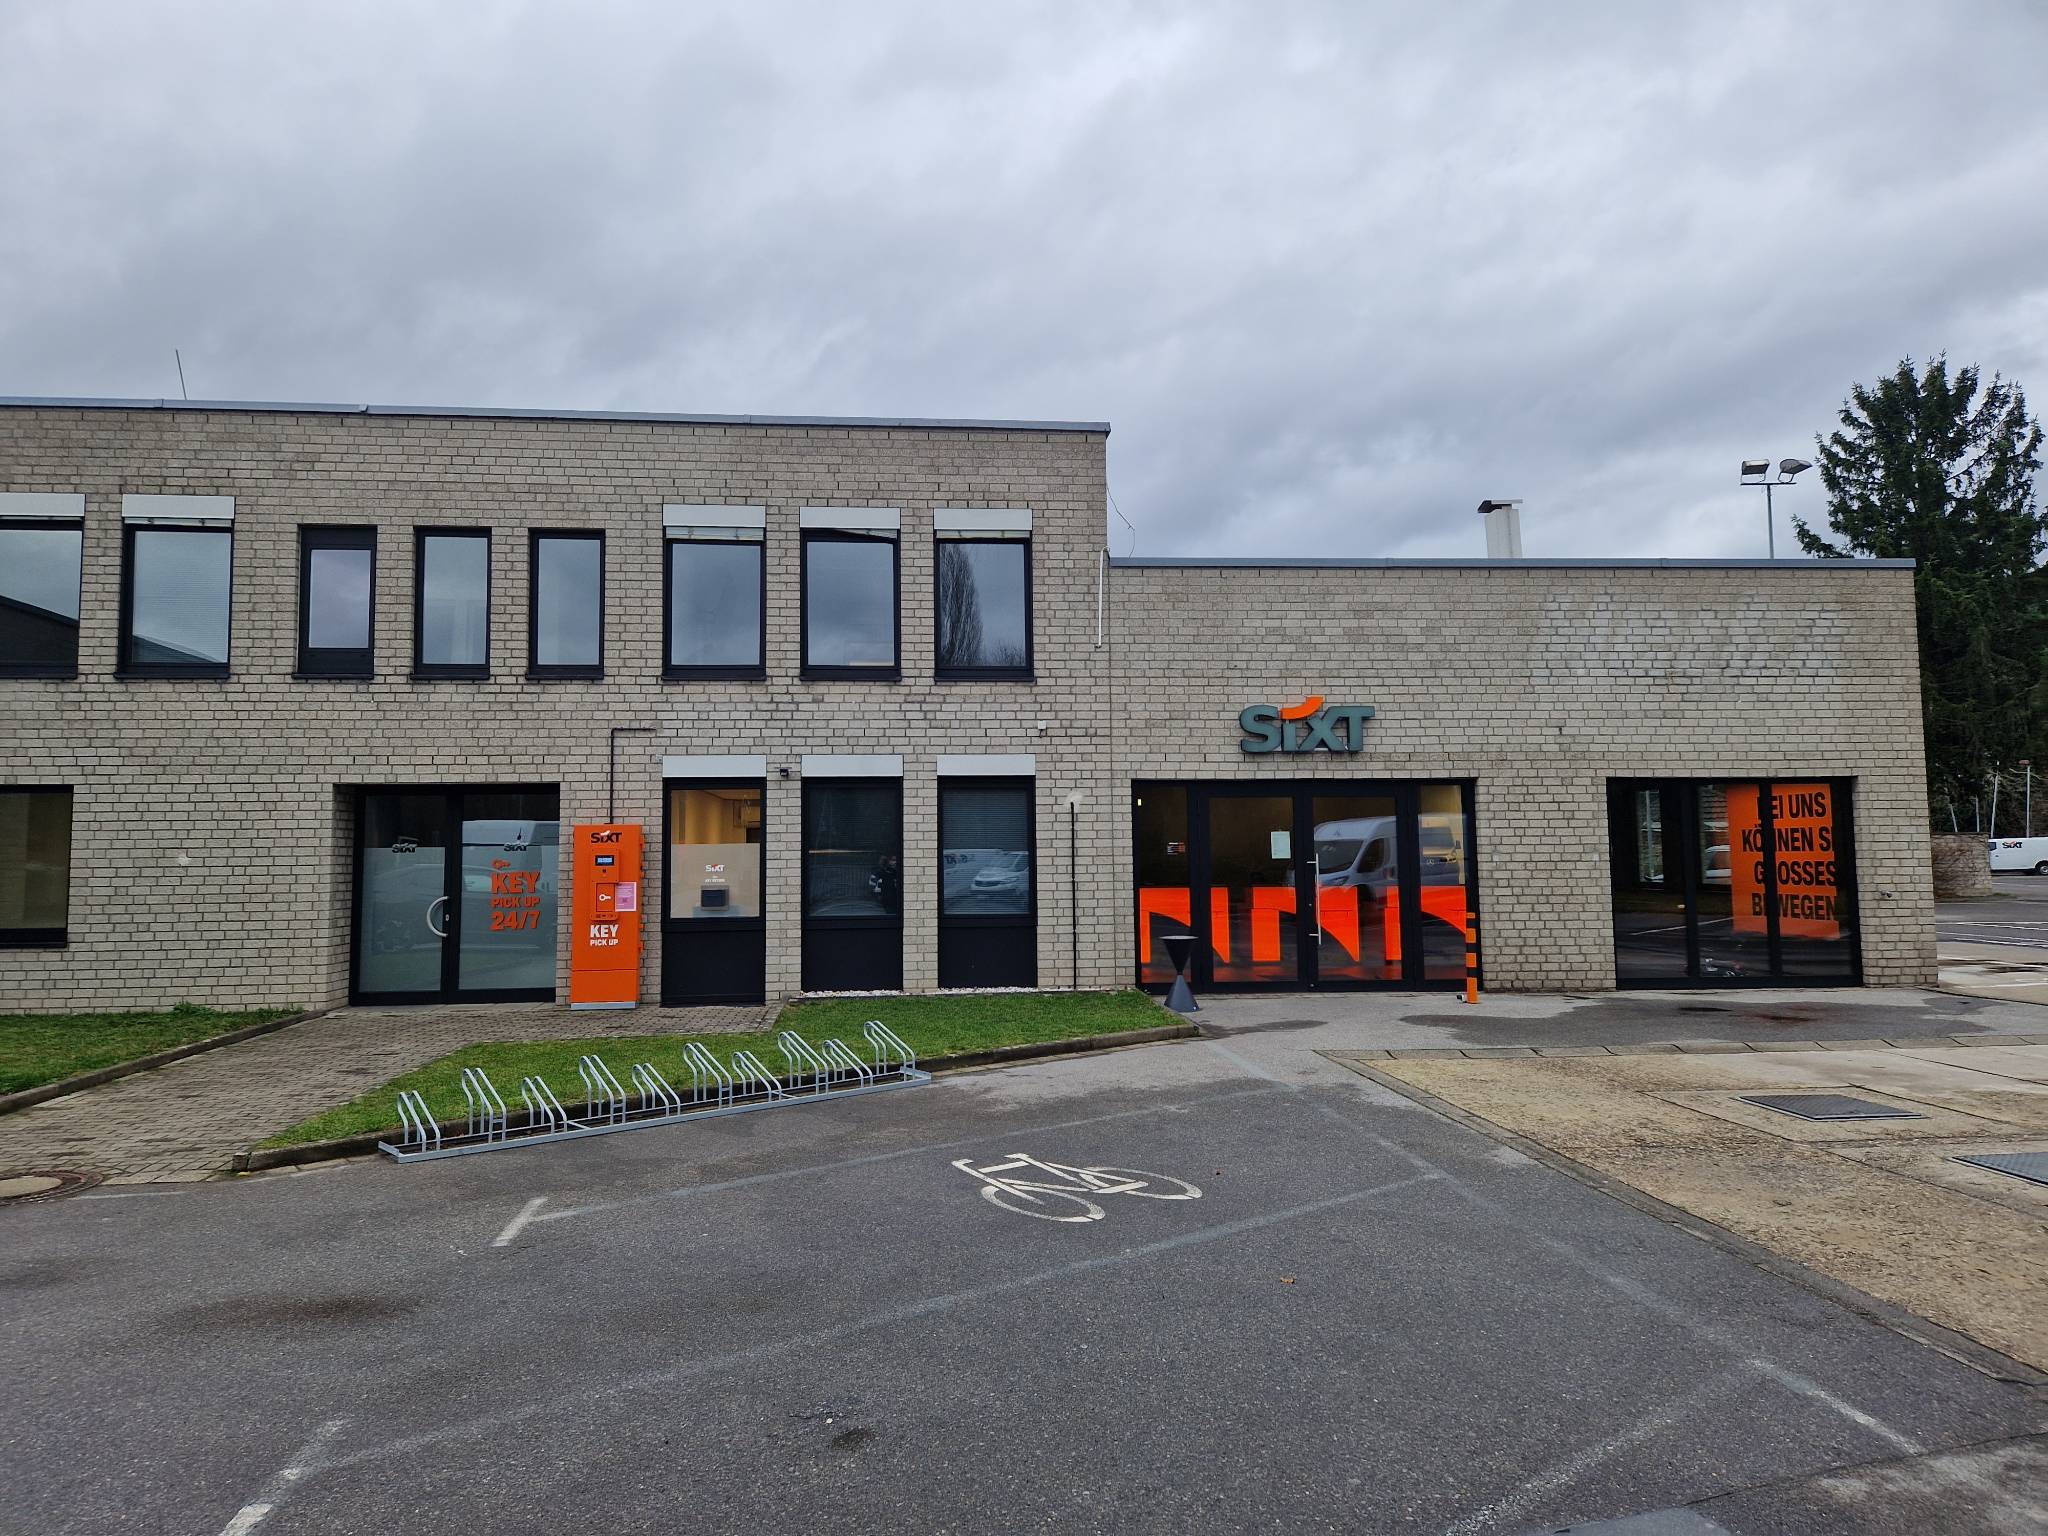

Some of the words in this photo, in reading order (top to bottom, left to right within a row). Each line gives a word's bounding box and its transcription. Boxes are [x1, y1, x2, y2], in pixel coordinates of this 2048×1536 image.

[1788, 792, 1827, 819] UNS
[1741, 823, 1815, 852] KÖNEN
[491, 871, 540, 894] KEY
[1754, 860, 1838, 887] GOSSES
[491, 896, 521, 909] PICK
[524, 896, 541, 908] UP
[490, 911, 541, 931] 24/7
[590, 924, 619, 938] KEY
[590, 938, 608, 946] PICK
[608, 938, 619, 946] UP
